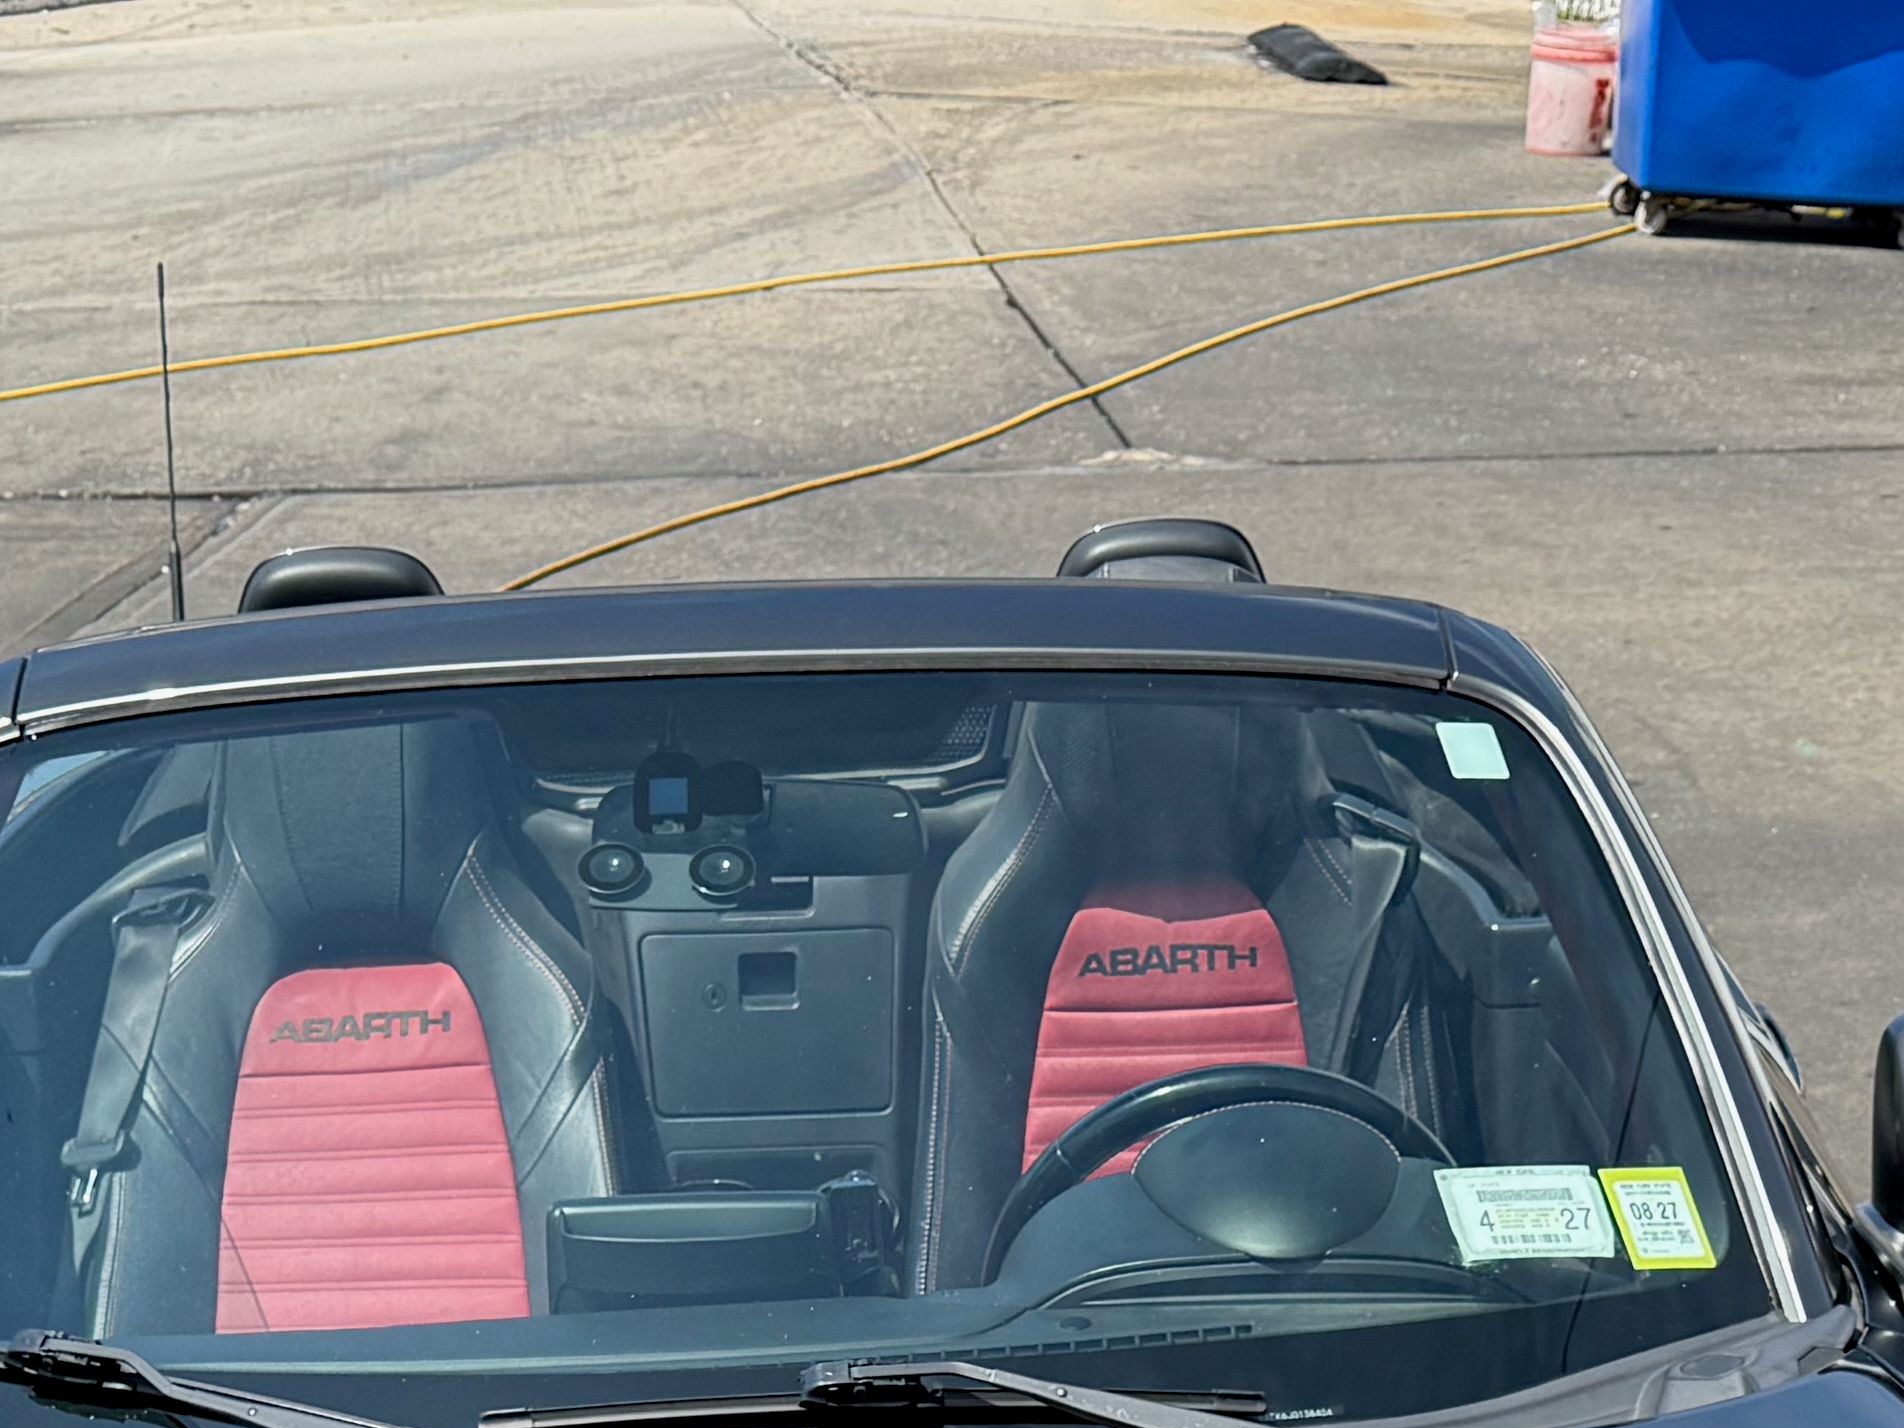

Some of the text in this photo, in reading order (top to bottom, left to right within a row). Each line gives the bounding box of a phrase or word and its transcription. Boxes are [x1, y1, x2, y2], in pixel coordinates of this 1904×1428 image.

[1078, 944, 1258, 978] ABARTH
[268, 1010, 452, 1044] ABARTH
[1479, 1209, 1496, 1232] 4
[1559, 1207, 1592, 1231] 27
[1629, 1201, 1678, 1221] 08 27
